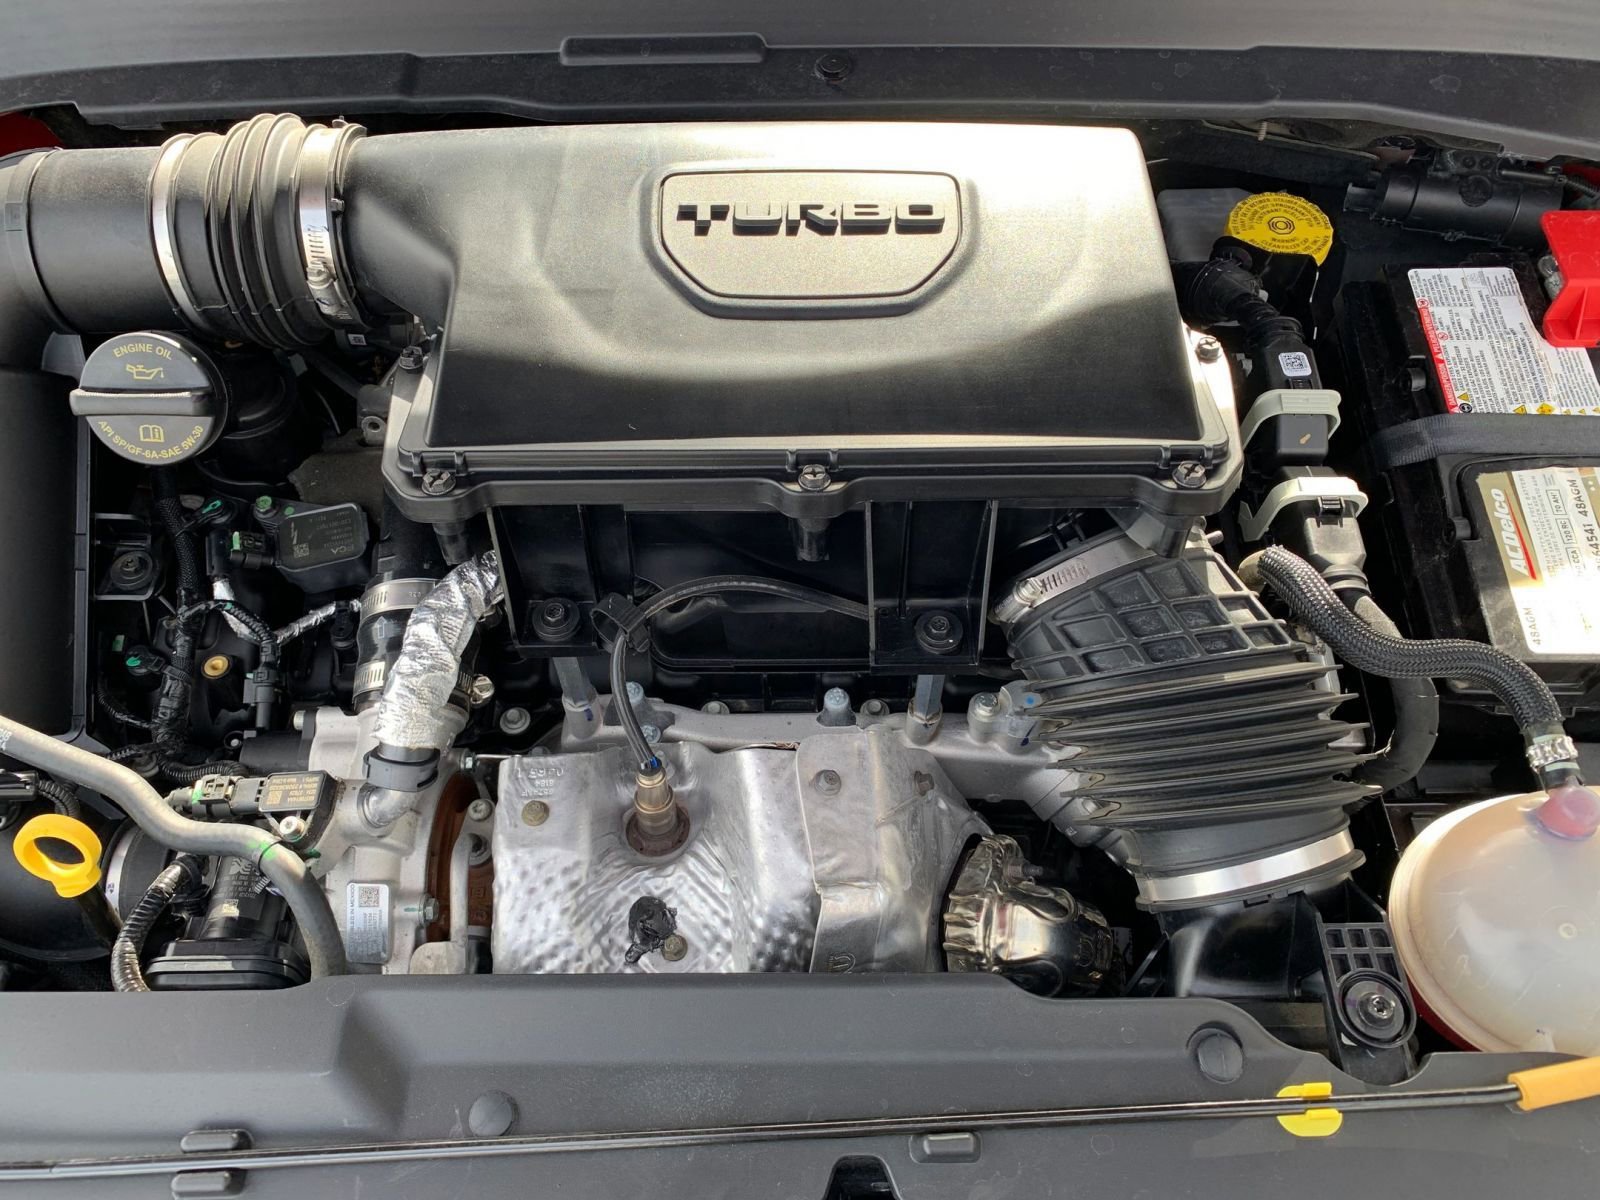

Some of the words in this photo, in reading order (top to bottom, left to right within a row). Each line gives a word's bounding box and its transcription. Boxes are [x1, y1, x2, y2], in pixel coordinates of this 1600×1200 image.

[677, 200, 946, 236] TURBO
[113, 343, 153, 357] ENGINE
[155, 346, 173, 361] OIL
[98, 420, 114, 438] API
[112, 435, 183, 459] SP/GF-6A-SAE
[182, 425, 204, 450] 5W-30
[1567, 479, 1589, 517] 48AGM
[1491, 488, 1530, 577] ACDelco
[1561, 520, 1569, 529] RC
[1571, 549, 1581, 564] CCA
[1523, 607, 1541, 645] 48AGM
